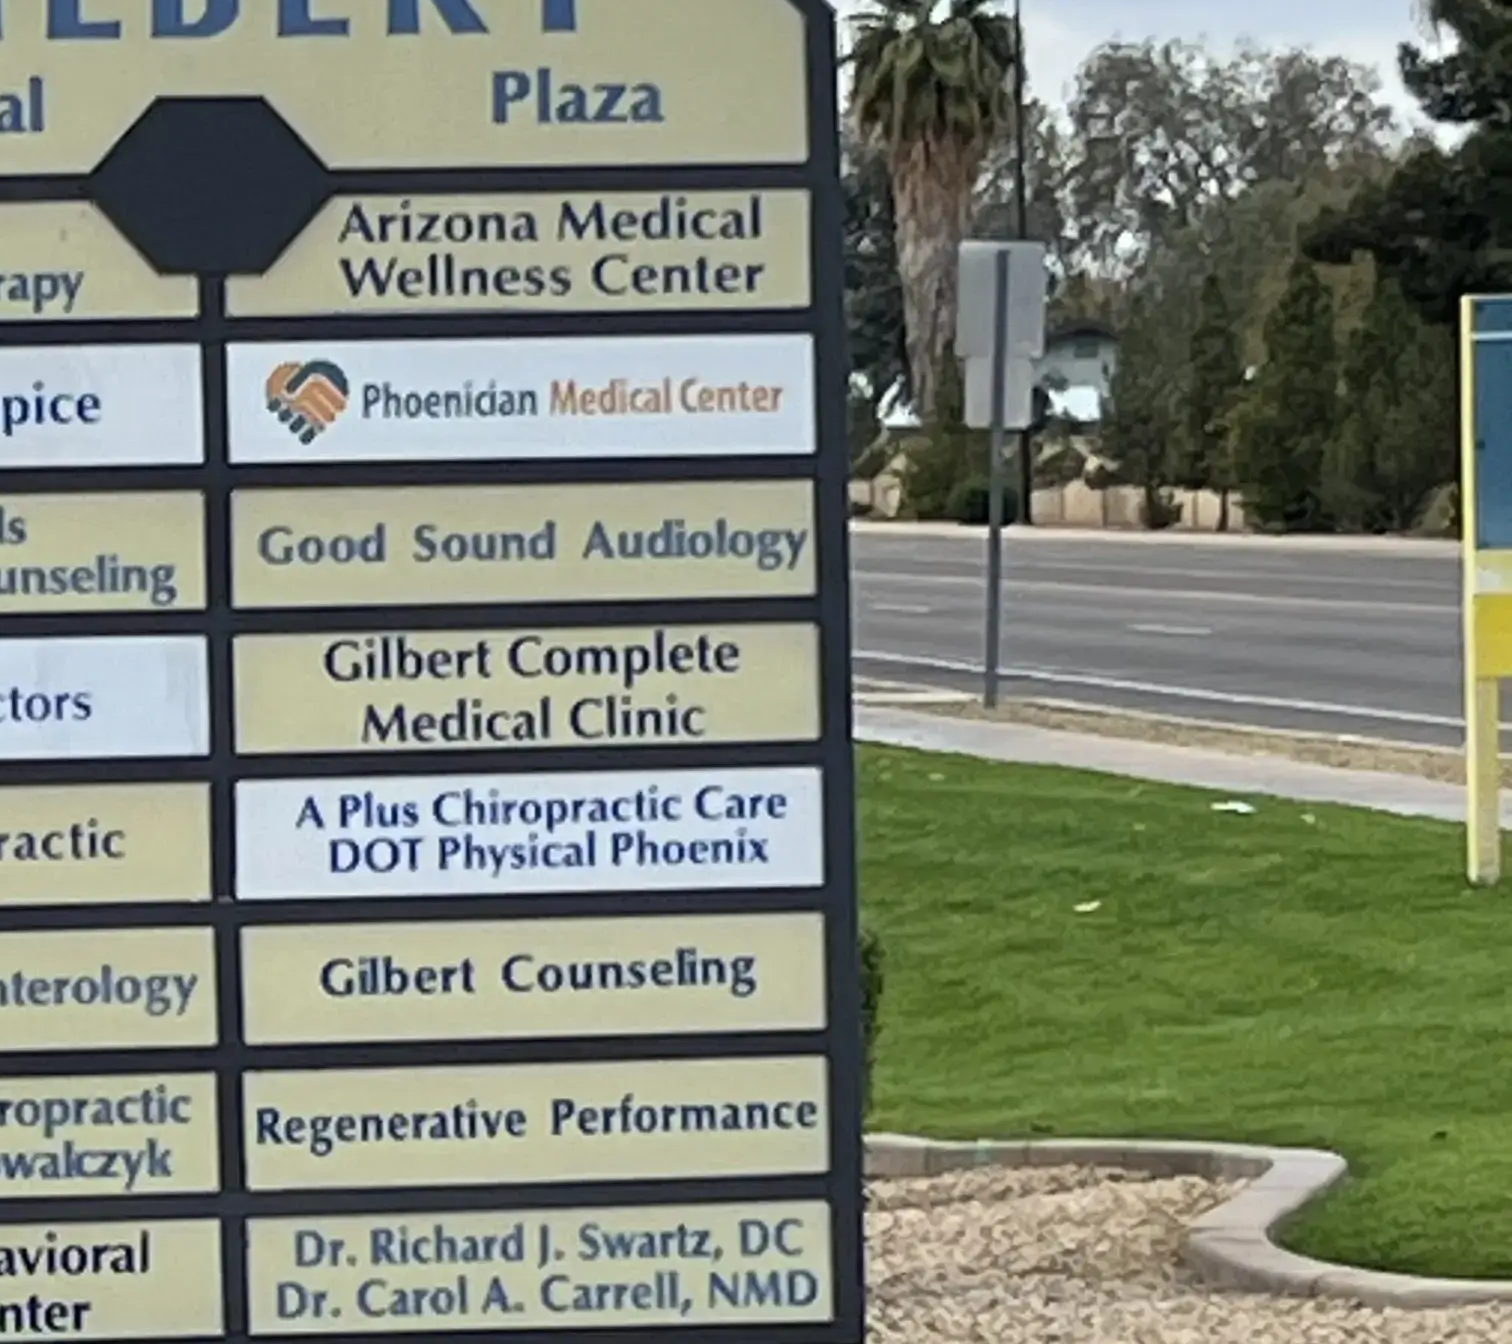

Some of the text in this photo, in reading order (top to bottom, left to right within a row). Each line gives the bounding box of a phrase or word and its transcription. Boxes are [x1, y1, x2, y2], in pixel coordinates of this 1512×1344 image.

[492, 66, 665, 125] Plaza
[338, 194, 761, 243] Arizona Medical
[339, 252, 765, 298] Wellness Center
[362, 376, 784, 419] Phoenician Medical Center
[258, 517, 808, 571] Good Sound Audiology
[323, 628, 740, 690] Gilbert Complete
[361, 693, 705, 743] Medical Clinic
[295, 785, 787, 834] A Plus Chiropractic Care
[329, 828, 769, 877] DOT Physical Phoenix
[320, 947, 757, 998] Gilbert Counseling
[256, 1093, 818, 1158] Regenerative Performance
[294, 1218, 803, 1269] Dr. Richard J. Swartz, DC
[276, 1269, 818, 1320] Dr. Carol A. Carrell, NMD
